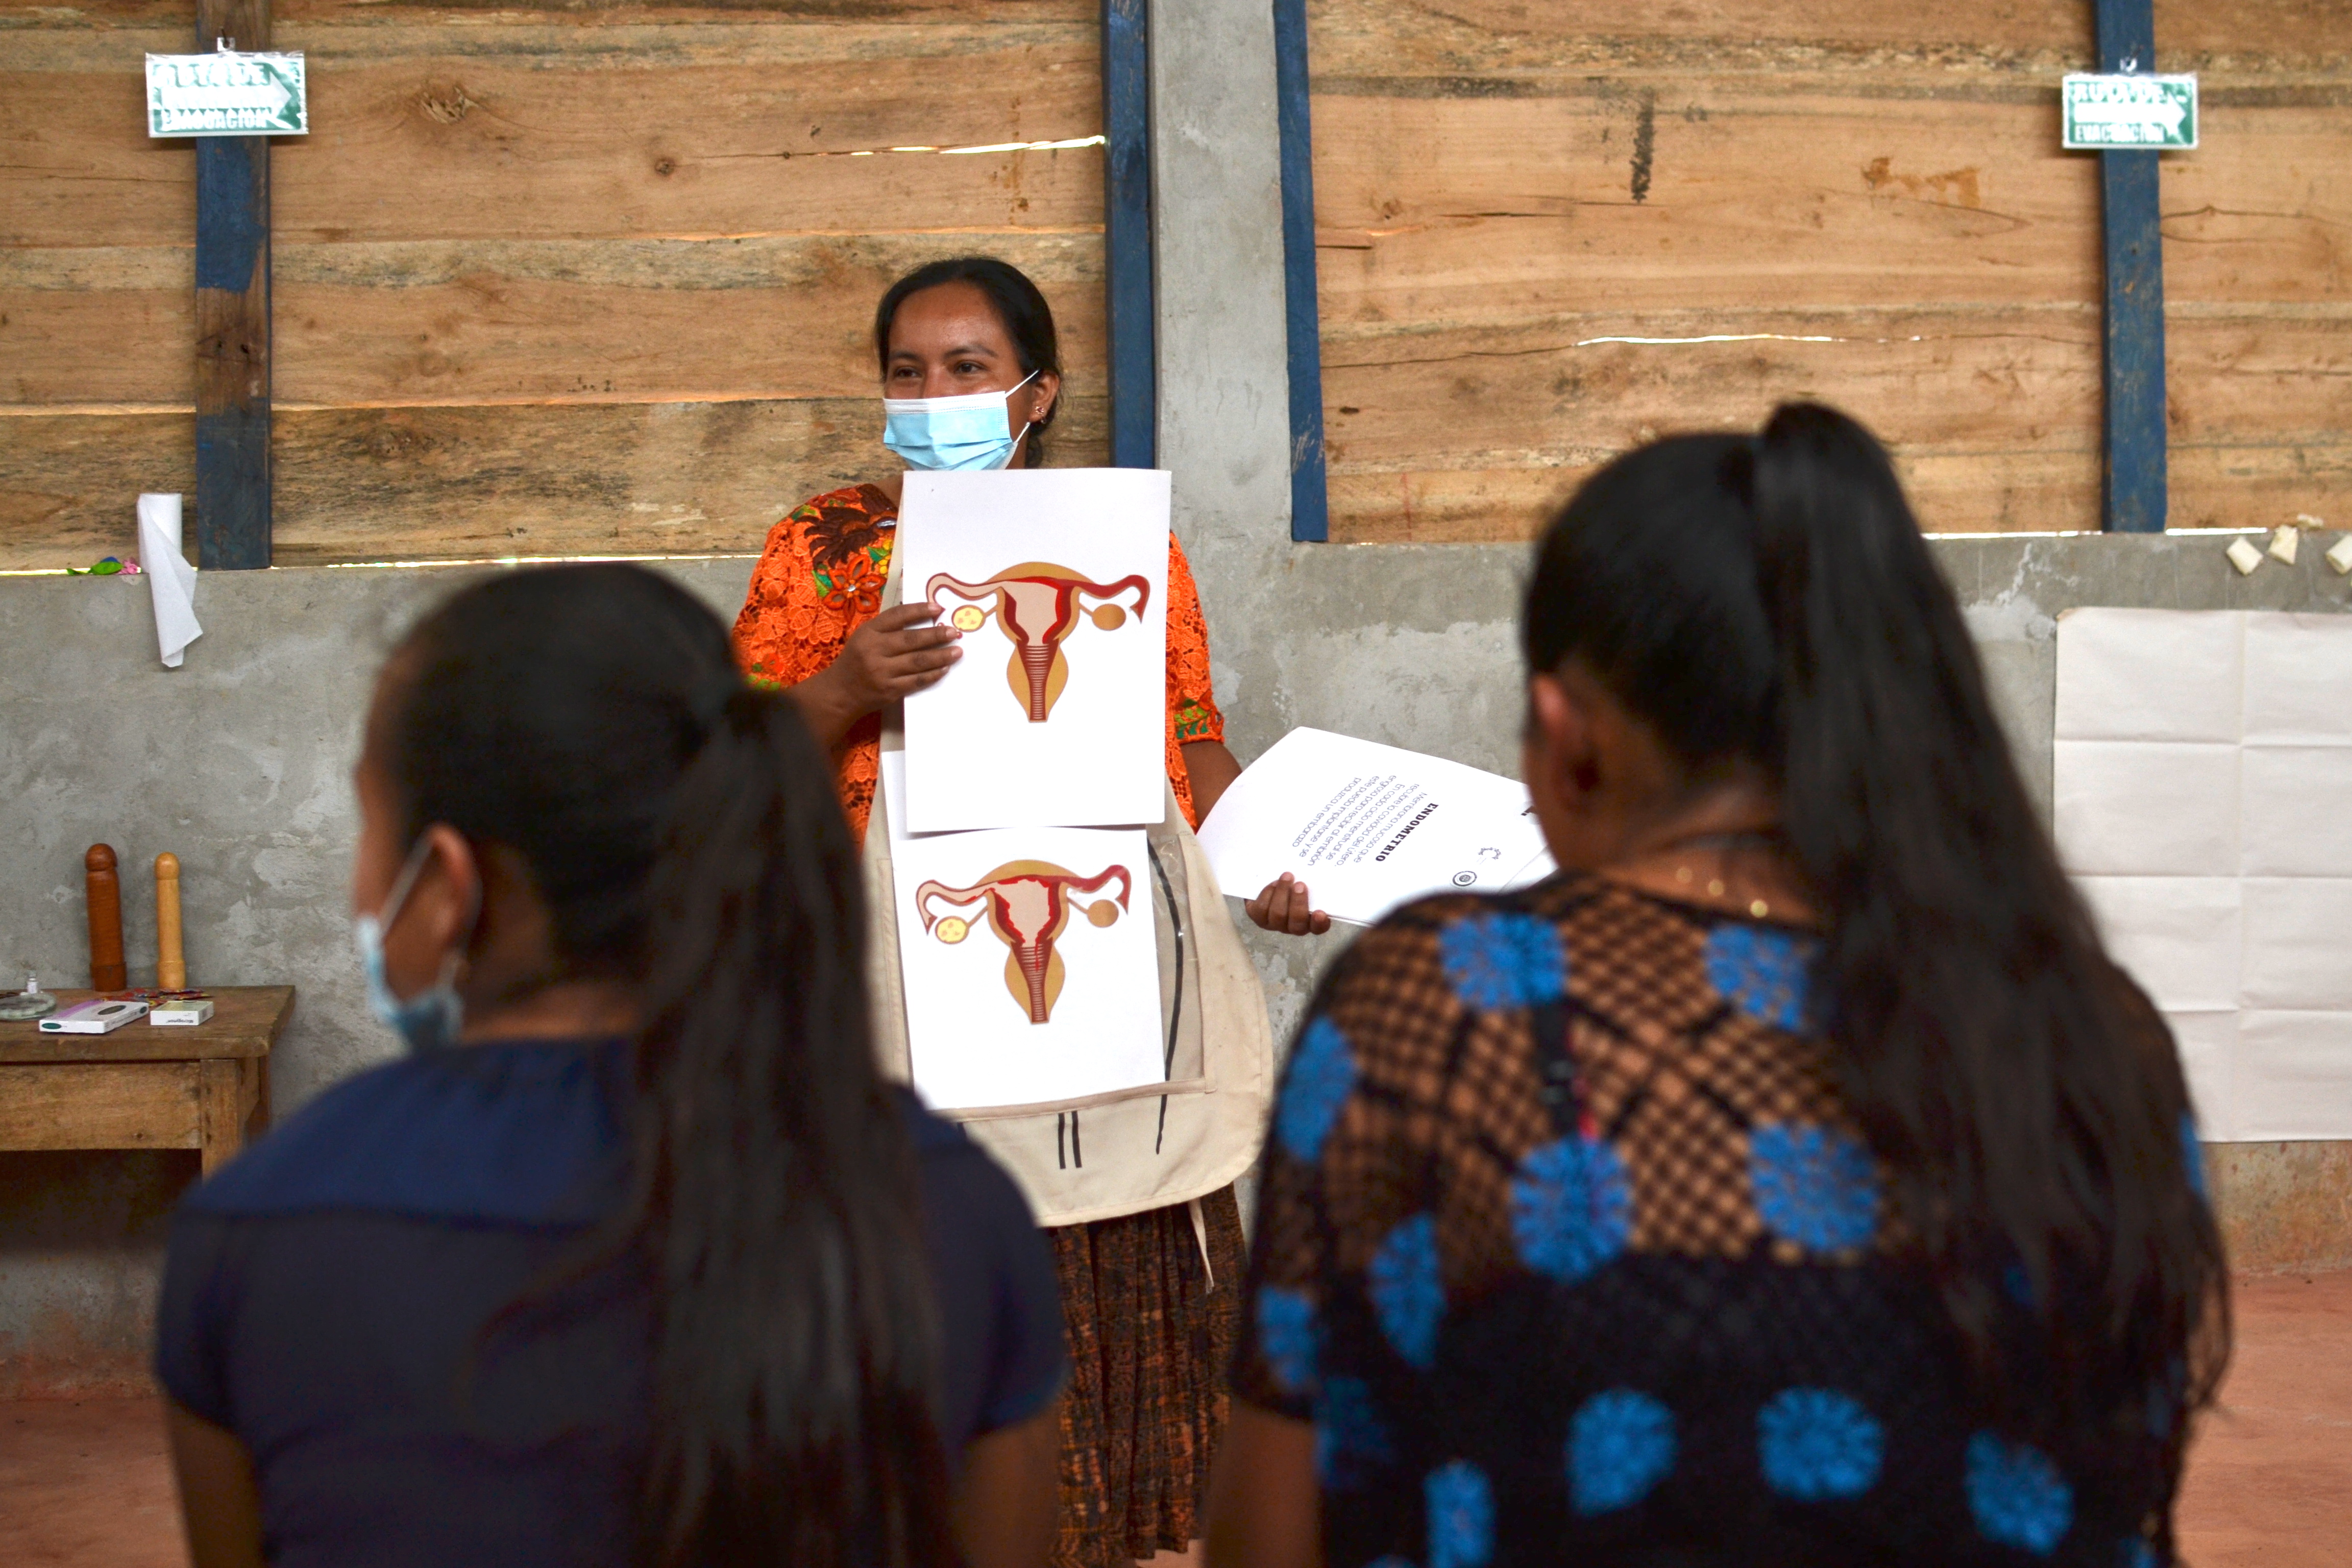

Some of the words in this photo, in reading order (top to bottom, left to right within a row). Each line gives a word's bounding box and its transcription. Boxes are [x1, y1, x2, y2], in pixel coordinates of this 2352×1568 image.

[1330, 777, 1362, 804] produzca
[1364, 776, 1380, 787] este
[1369, 775, 1396, 797] engrosa
[1343, 787, 1367, 806] pueda
[1355, 796, 1373, 811] para
[1375, 791, 1395, 806] cada
[1393, 783, 1420, 804] recubre
[1361, 806, 1378, 820] ciclo
[1390, 792, 1428, 823] Membrana
[1292, 813, 1325, 847] embarazo
[1310, 806, 1349, 842] implantarse
[1337, 810, 1358, 829] recibir
[1361, 811, 1390, 836] cavidad
[1333, 821, 1364, 852] menstrual
[1352, 836, 1364, 847] del
[1365, 823, 1393, 848] mucosa
[1375, 802, 1439, 862] ENDOMETRIO
[1307, 836, 1339, 866] embrión
[1334, 847, 1356, 867] útero.
[1353, 849, 1369, 863] que
